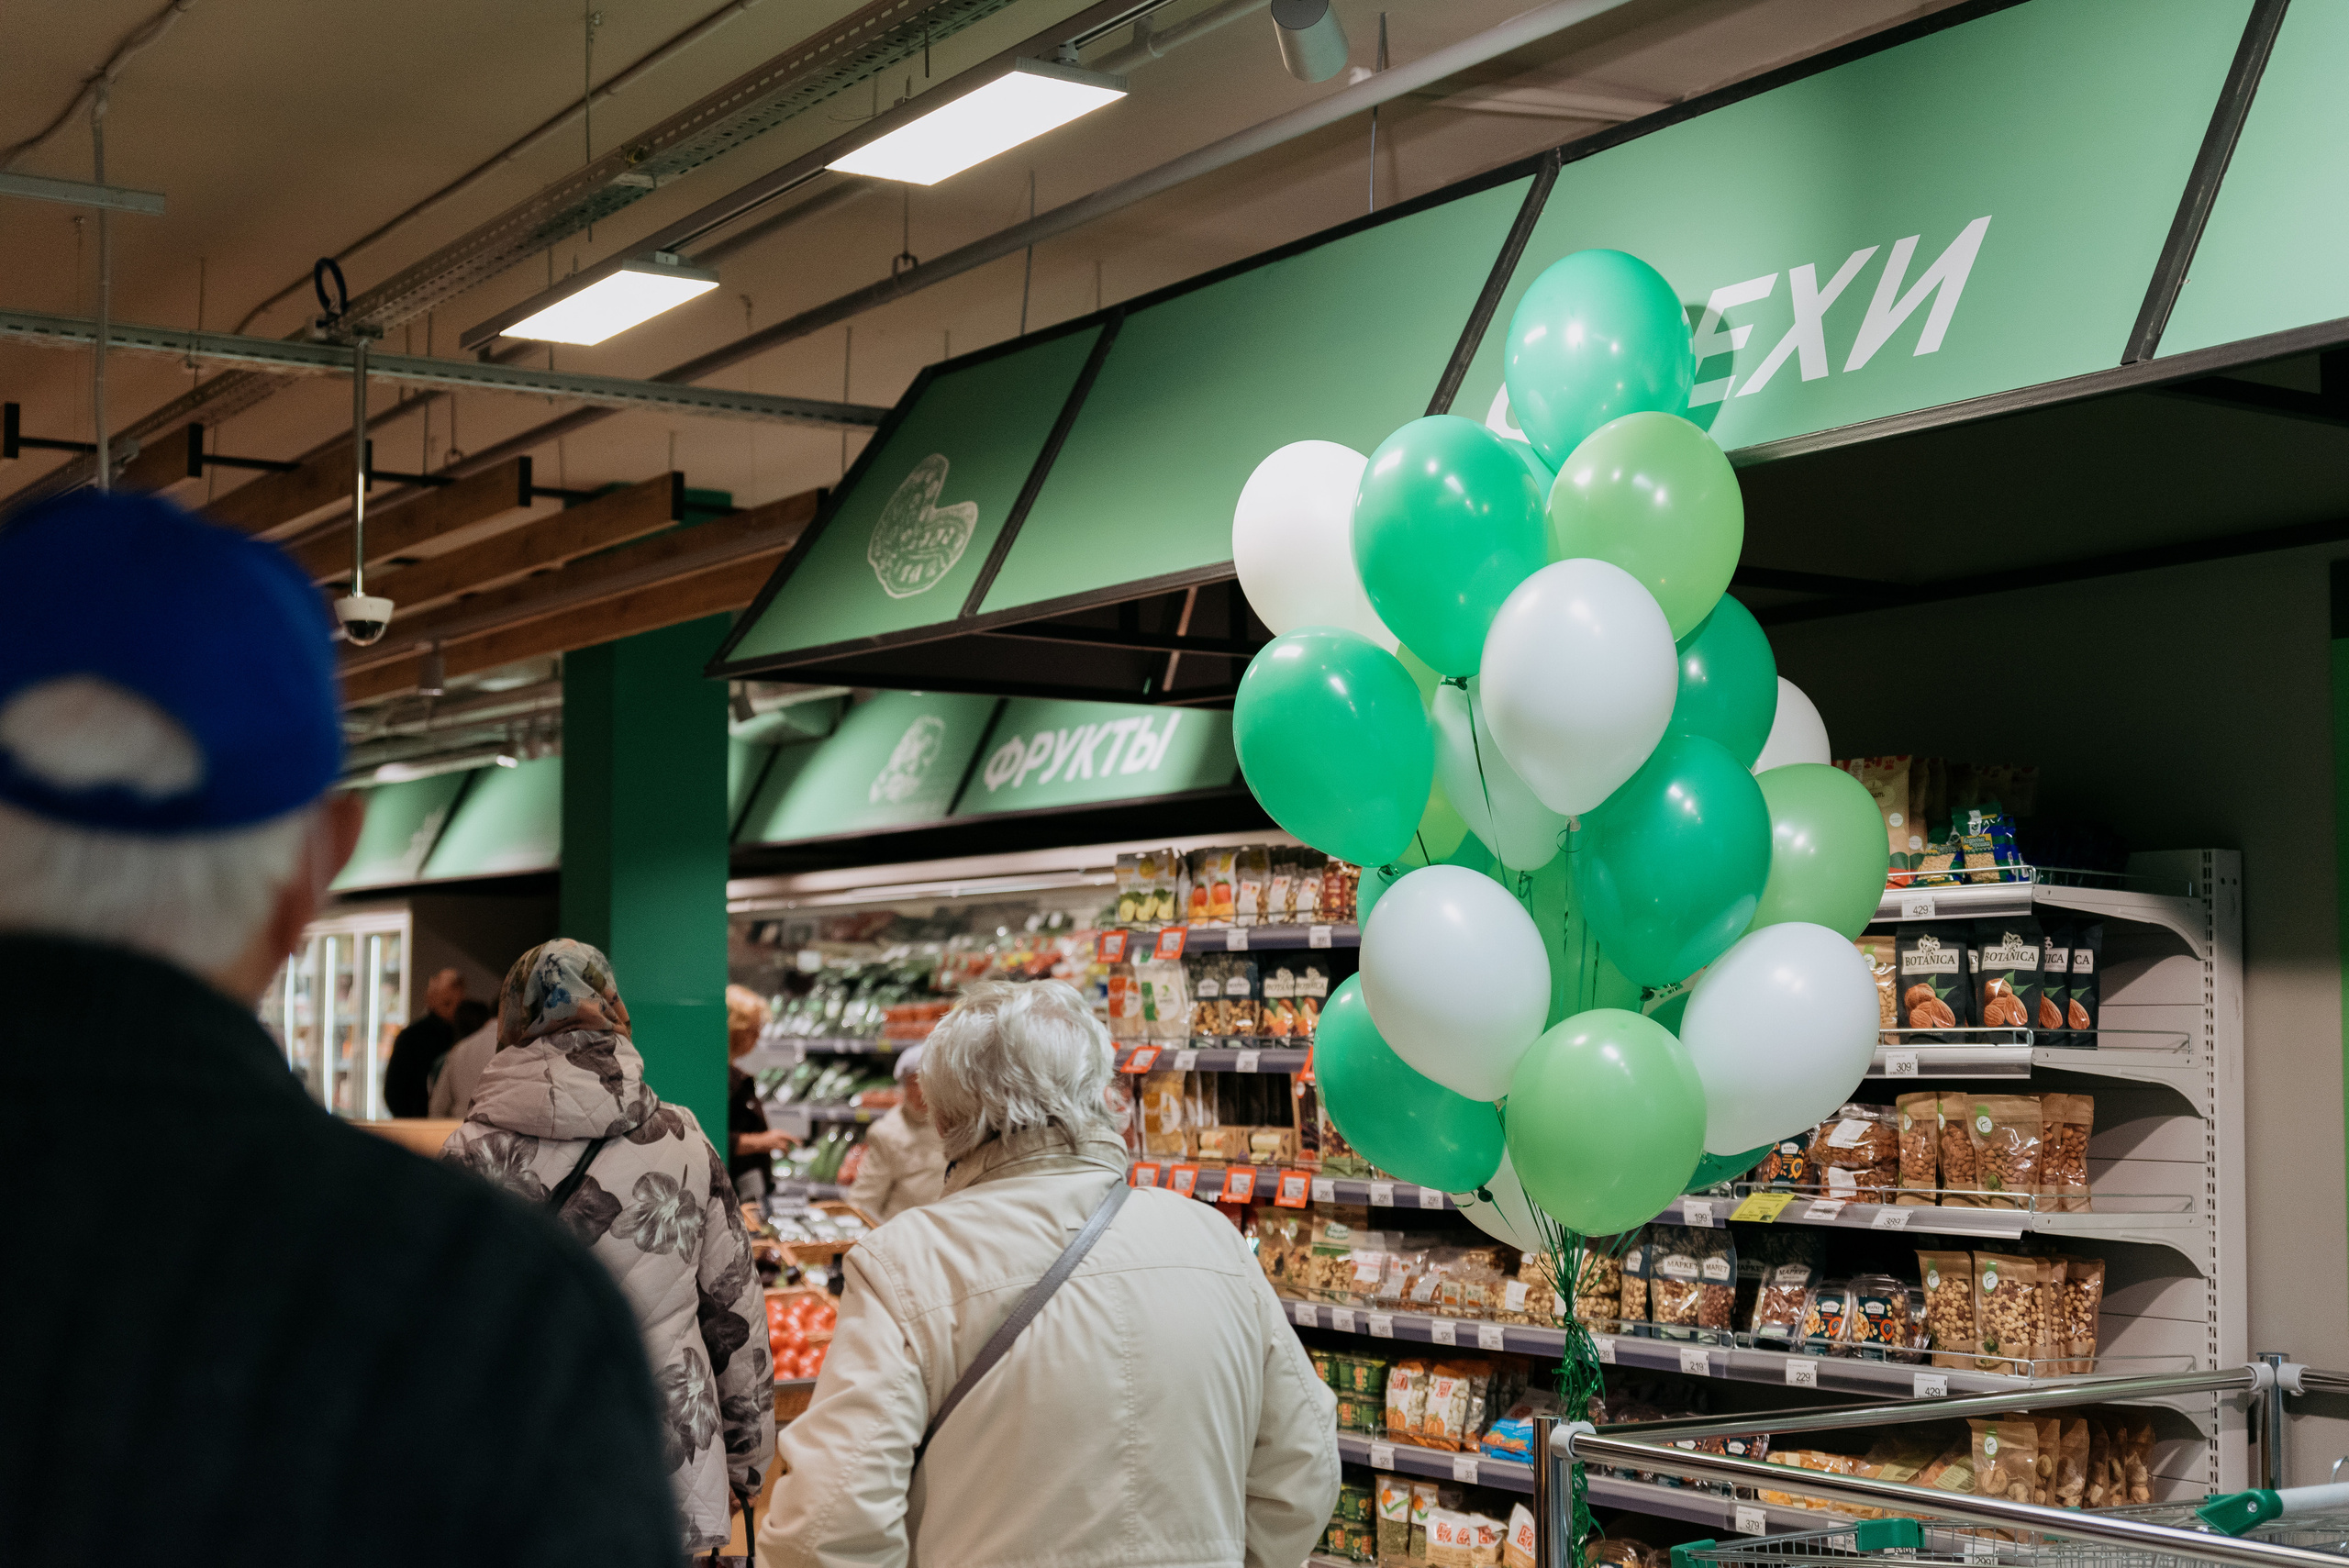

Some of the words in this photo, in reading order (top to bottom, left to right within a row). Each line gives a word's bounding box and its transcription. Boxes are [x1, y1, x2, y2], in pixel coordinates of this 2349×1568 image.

[1485, 215, 1992, 442] ЕХИ
[984, 710, 1183, 792] ФРУКТЫ
[1912, 905, 1929, 915] 429
[1905, 954, 1955, 966] BOTANICA
[1984, 951, 2035, 962] BOTANICA
[1896, 1062, 1912, 1073] 309
[1695, 1213, 1708, 1222] 199
[1883, 1218, 1901, 1226] 389
[1666, 1260, 1698, 1270] МАРКЕТ
[1689, 1361, 1704, 1371] 219
[1796, 1372, 1811, 1382] 229
[1924, 1386, 1941, 1396] 429
[1745, 1519, 1760, 1530] 379
